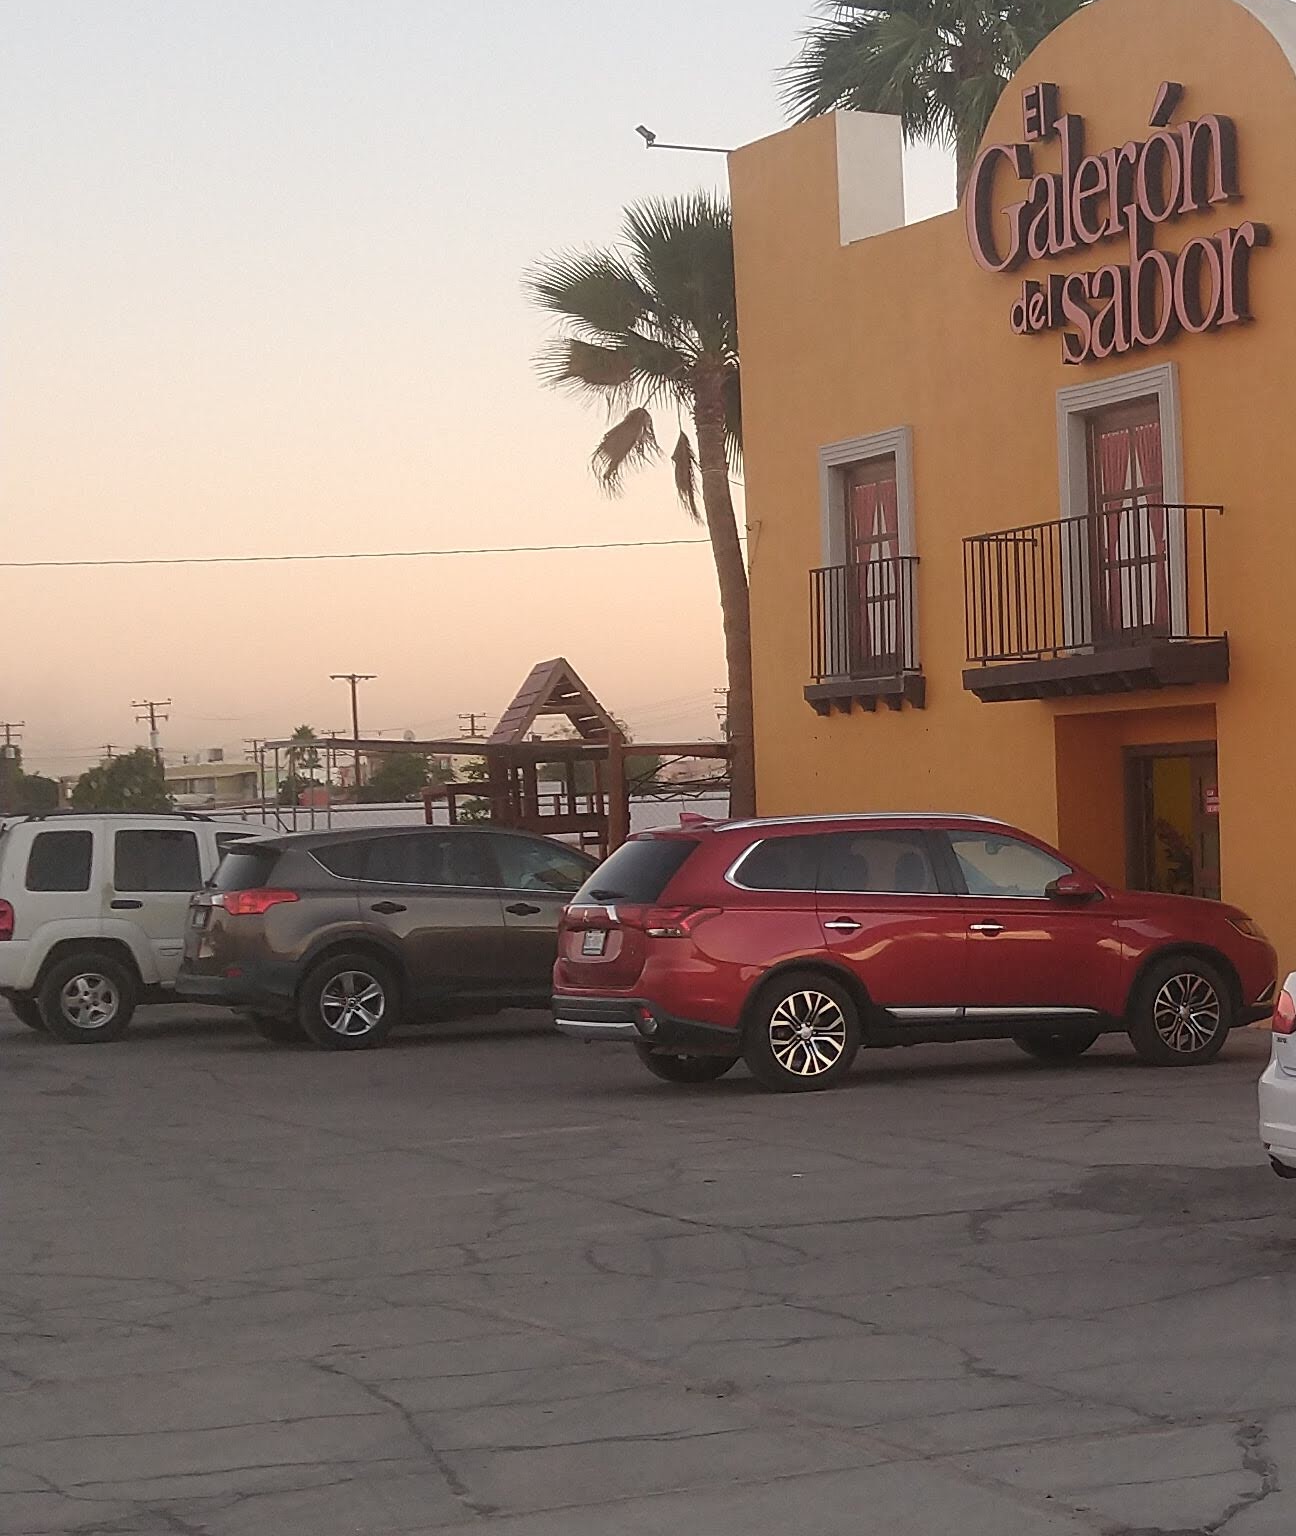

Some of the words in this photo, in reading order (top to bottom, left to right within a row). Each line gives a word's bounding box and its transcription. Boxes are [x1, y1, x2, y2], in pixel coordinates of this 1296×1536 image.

[965, 81, 1241, 272] Galerón
[1022, 82, 1055, 141] El
[1010, 274, 1058, 334] del
[1061, 204, 1266, 364] sabor
